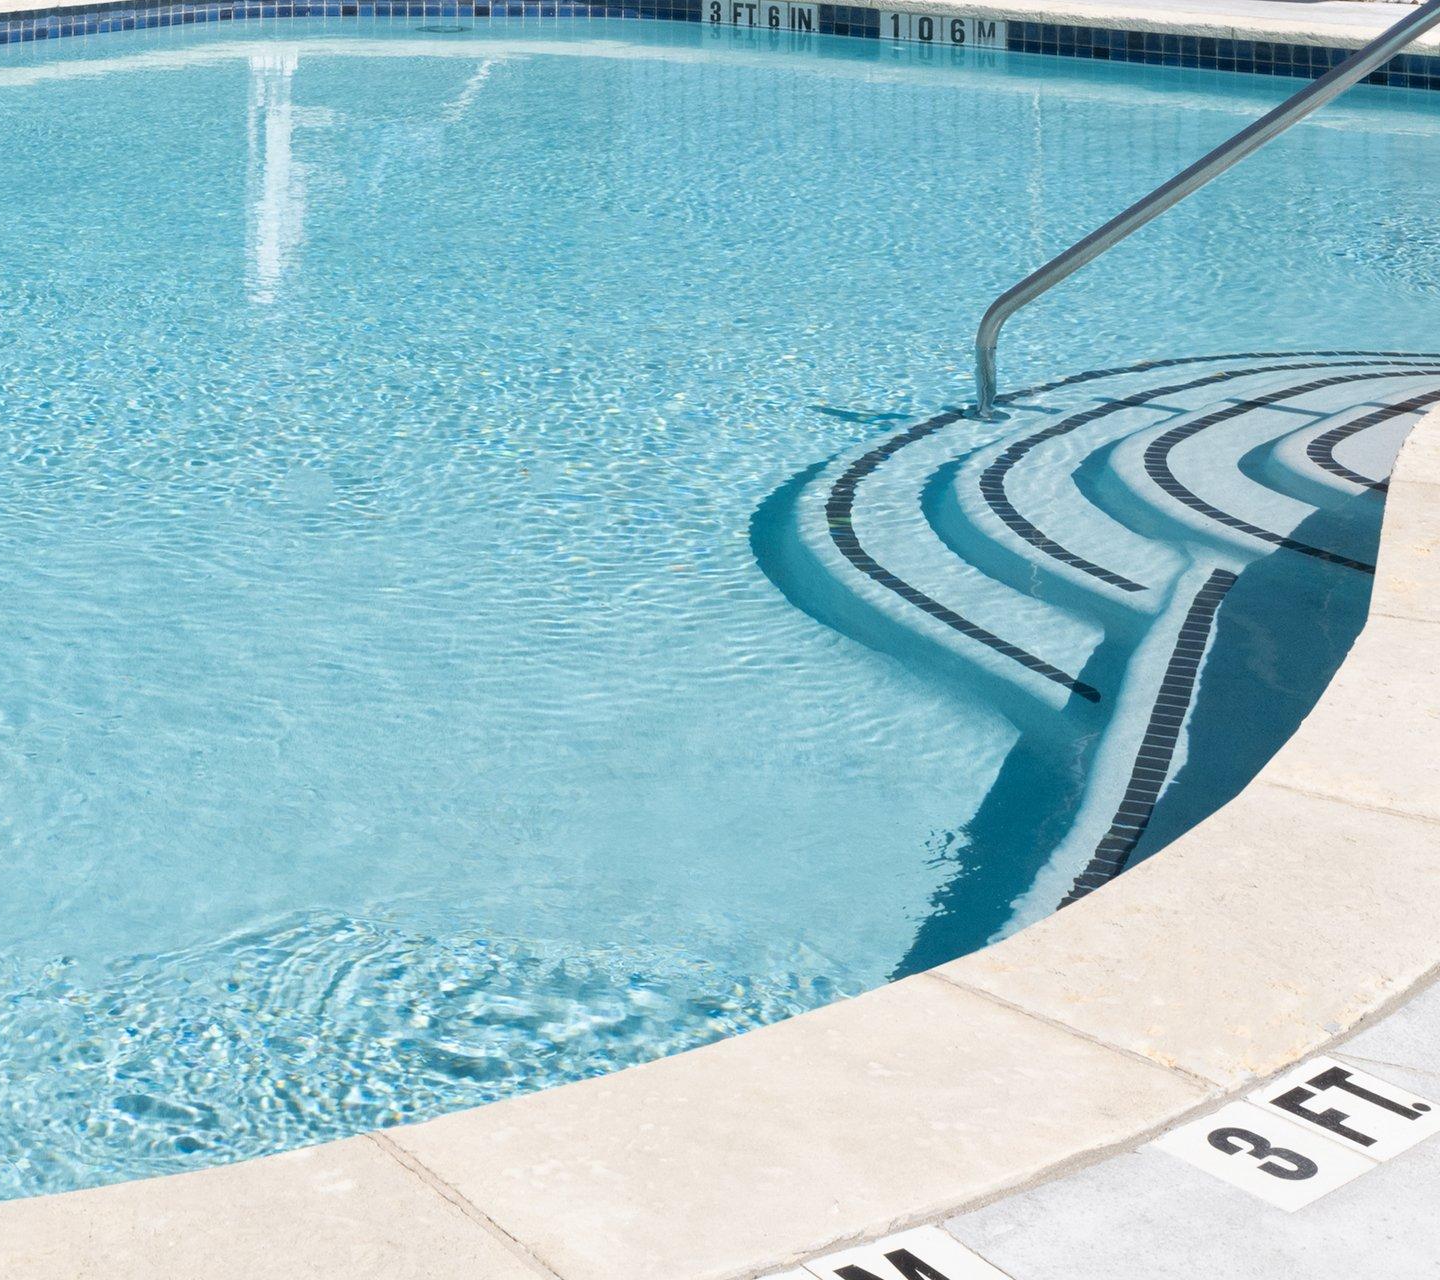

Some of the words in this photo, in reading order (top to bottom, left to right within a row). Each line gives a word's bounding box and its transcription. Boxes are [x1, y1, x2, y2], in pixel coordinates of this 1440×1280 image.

[710, 1, 721, 23] 3
[768, 5, 780, 28] 6
[978, 20, 996, 44] M
[1207, 1126, 1319, 1182] 3
[1269, 1065, 1432, 1147] FT.
